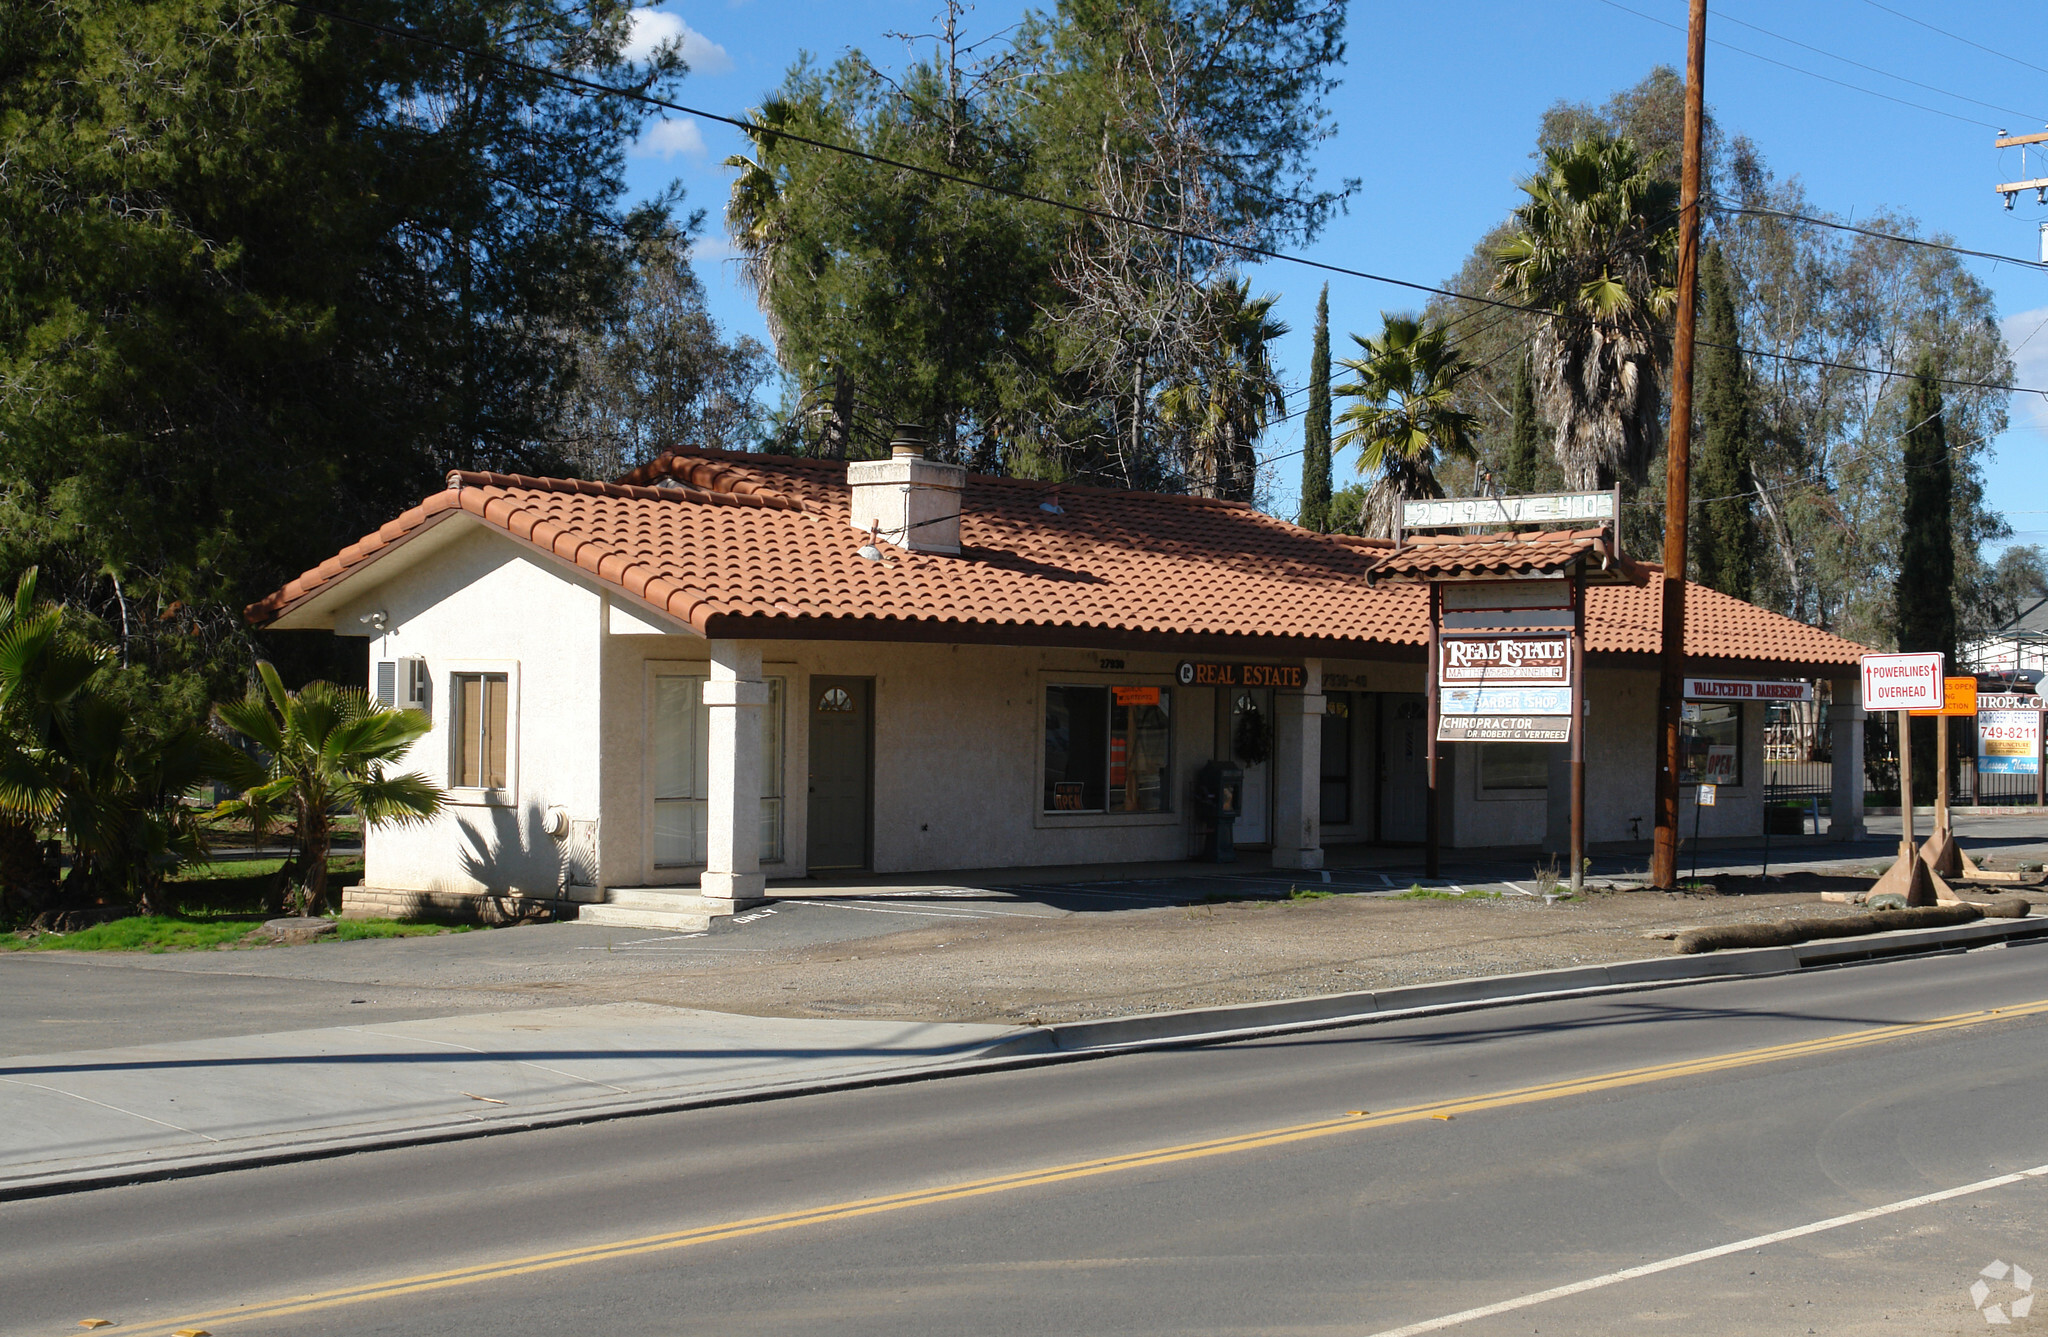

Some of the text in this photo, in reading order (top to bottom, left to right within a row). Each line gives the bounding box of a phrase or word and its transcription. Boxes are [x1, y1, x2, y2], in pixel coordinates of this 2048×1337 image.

[1446, 639, 1565, 667] REAL ESTATE
[1196, 664, 1236, 684] REAL
[1243, 666, 1301, 686] ESTATE
[1873, 665, 1930, 678] POWERLINES
[1878, 686, 1926, 699] OVERHEAD
[1443, 718, 1533, 729] CHIROPRACTOR
[1467, 730, 1480, 738] DR.
[1481, 730, 1512, 738] ROBERT
[1525, 730, 1566, 739] VERTREES
[1980, 726, 2037, 739] 749-8211
[1707, 753, 1733, 775] OPEN
[1979, 757, 2038, 773] Massage Therapy
[732, 908, 779, 924] ONLY
